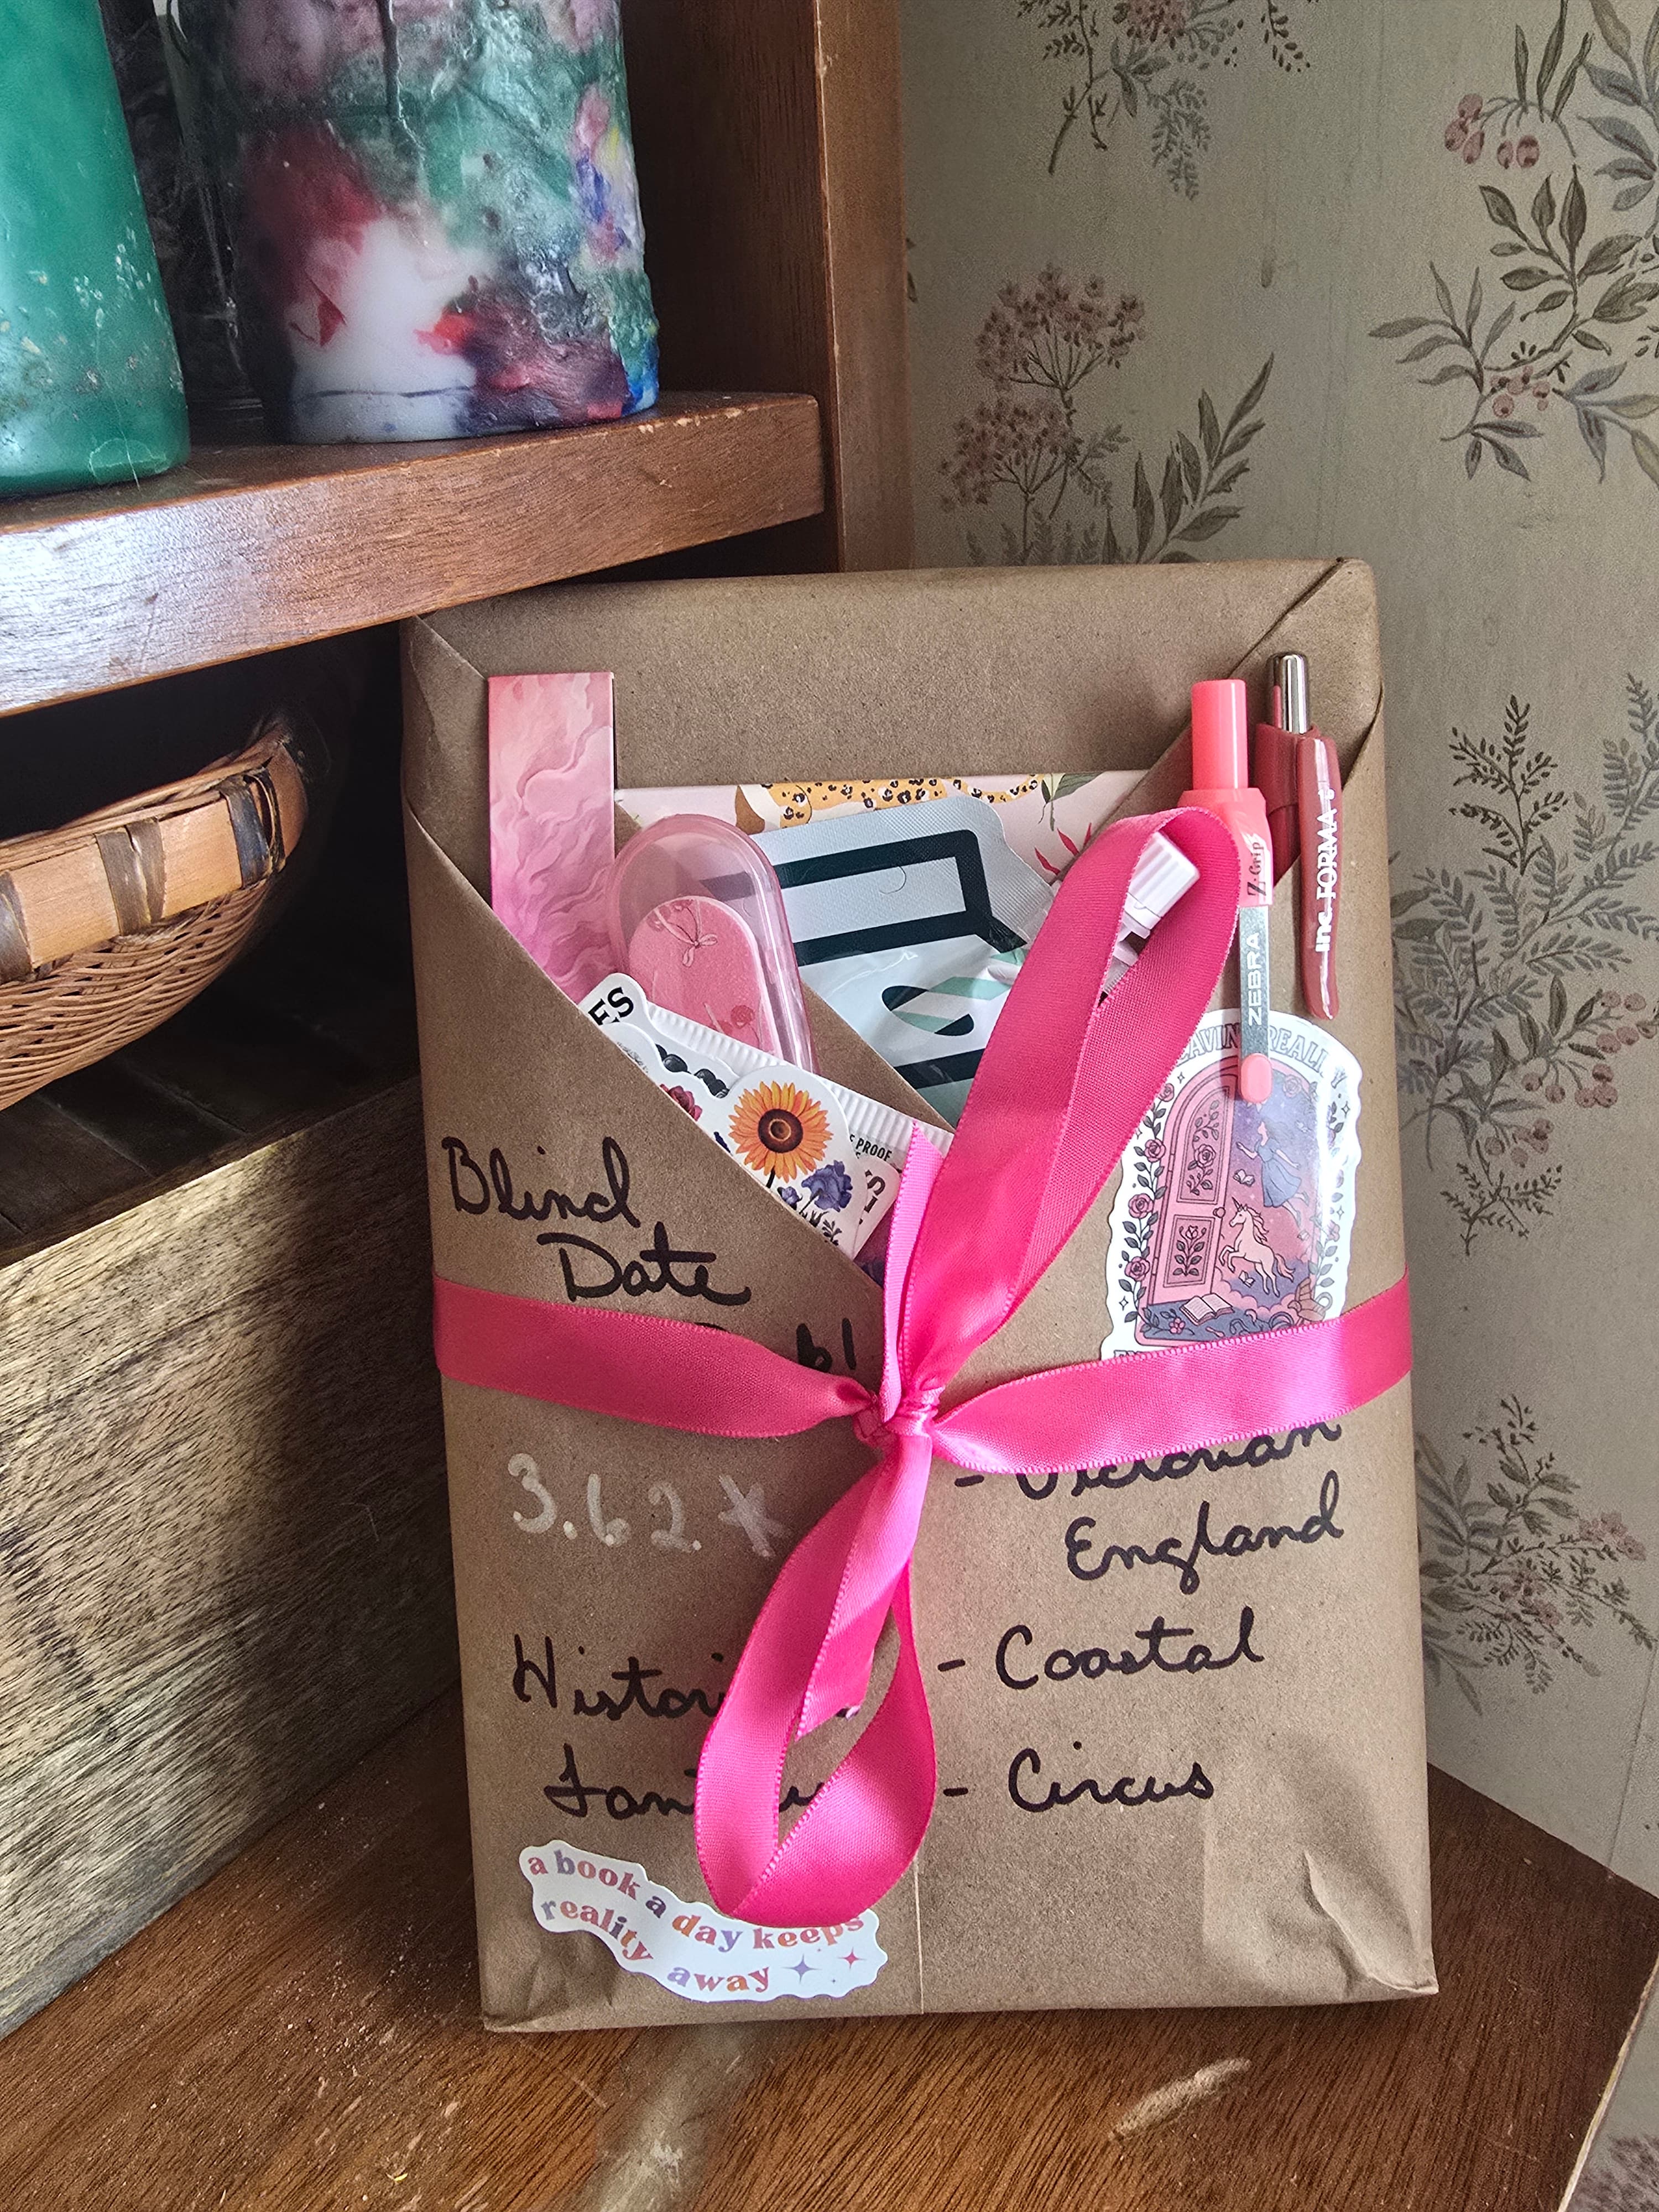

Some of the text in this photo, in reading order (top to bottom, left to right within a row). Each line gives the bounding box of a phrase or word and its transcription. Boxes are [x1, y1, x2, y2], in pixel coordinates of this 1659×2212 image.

[1316, 808, 1338, 901] FORMA
[1246, 932, 1262, 1027] ZEBRA
[442, 1136, 640, 1228] Blind
[855, 1138, 893, 1161] PROOF
[537, 1221, 752, 1306] Date
[1066, 1469, 1345, 1594] England
[995, 1605, 1265, 1691] Coastal
[1008, 1740, 1215, 1812] Circus
[528, 1856, 549, 1876] a
[554, 1849, 641, 1901] book
[645, 1895, 667, 1919] a
[672, 1914, 743, 1953] day
[540, 1900, 770, 1993] reality away
